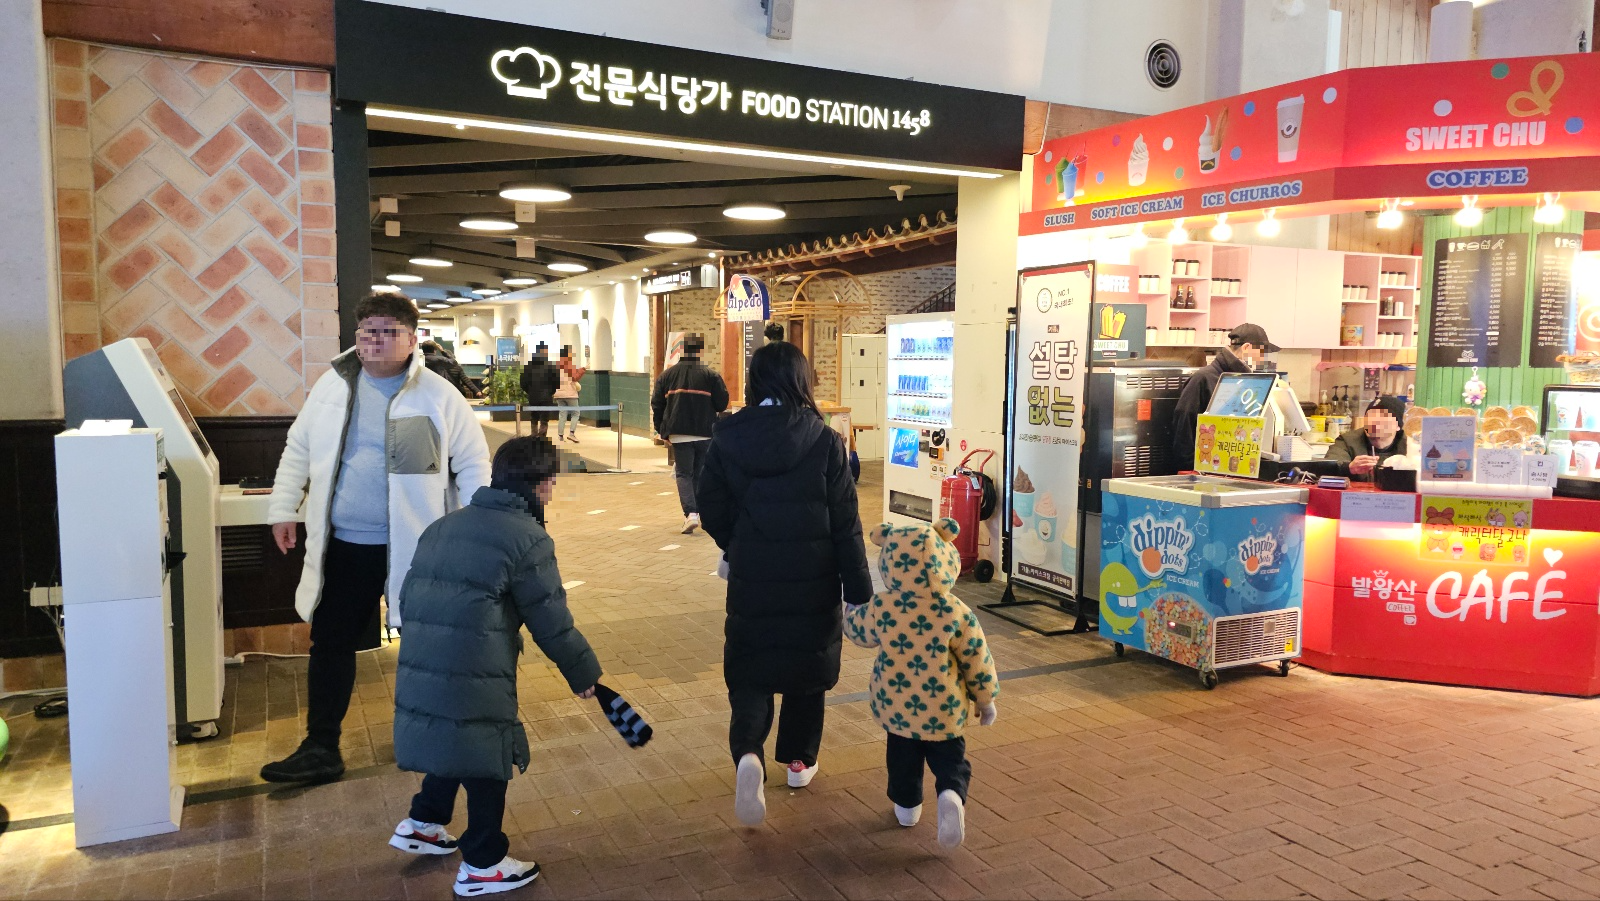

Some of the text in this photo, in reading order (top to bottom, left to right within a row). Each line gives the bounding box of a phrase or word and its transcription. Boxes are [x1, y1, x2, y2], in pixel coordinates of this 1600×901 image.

[569, 61, 931, 136] 전문식당가 FOOD STATION 1458
[1405, 120, 1547, 152] SWEET CHU
[1428, 167, 1528, 189] COFFEE
[1202, 180, 1303, 208] ICE CHURROS
[1044, 212, 1075, 226] SLUSH
[1091, 197, 1184, 220] SOFT ICE CREAM
[1028, 339, 1078, 381] 설탕
[1027, 385, 1076, 428] 없는
[1161, 550, 1184, 568] dots
[1166, 574, 1200, 588] ICE CREAM
[1351, 575, 1418, 601] 발왕산
